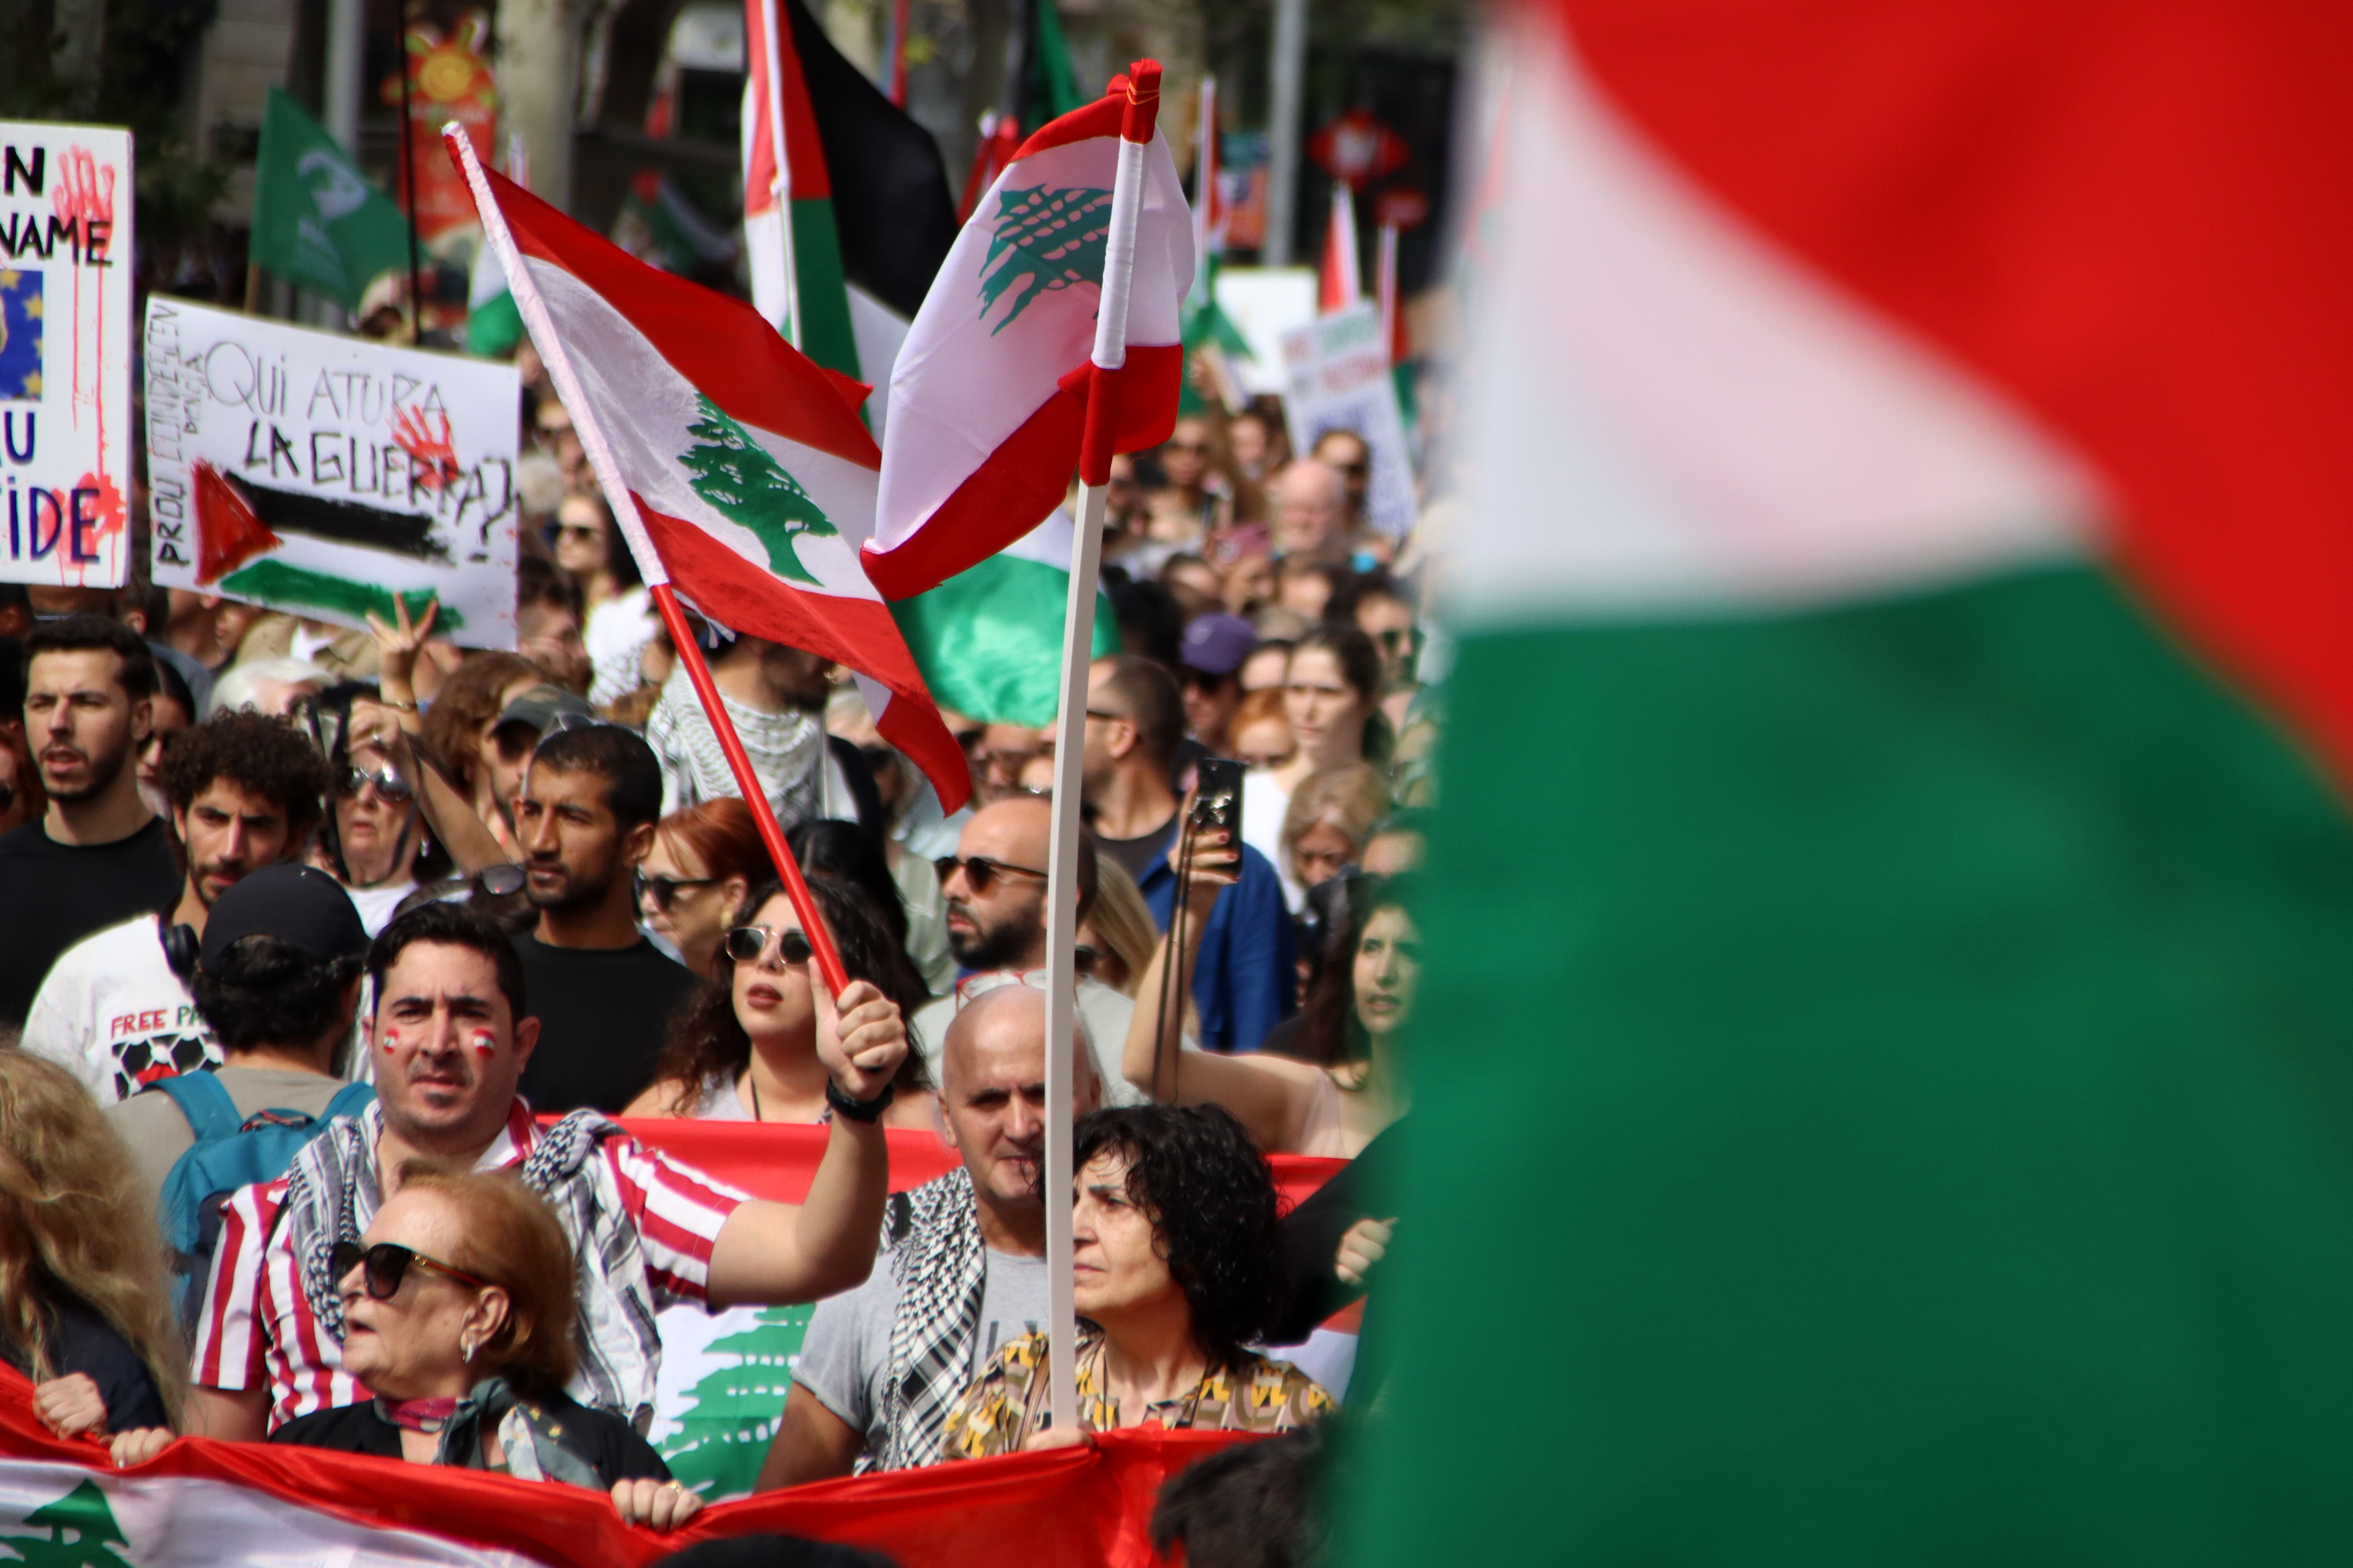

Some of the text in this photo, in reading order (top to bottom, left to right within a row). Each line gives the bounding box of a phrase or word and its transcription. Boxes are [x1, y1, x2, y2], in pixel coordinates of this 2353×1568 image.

[0, 212, 113, 268] NAME
[306, 366, 453, 435] ATURA
[245, 420, 300, 478] LA
[155, 476, 189, 567] PROU
[111, 1010, 167, 1039] FREE
